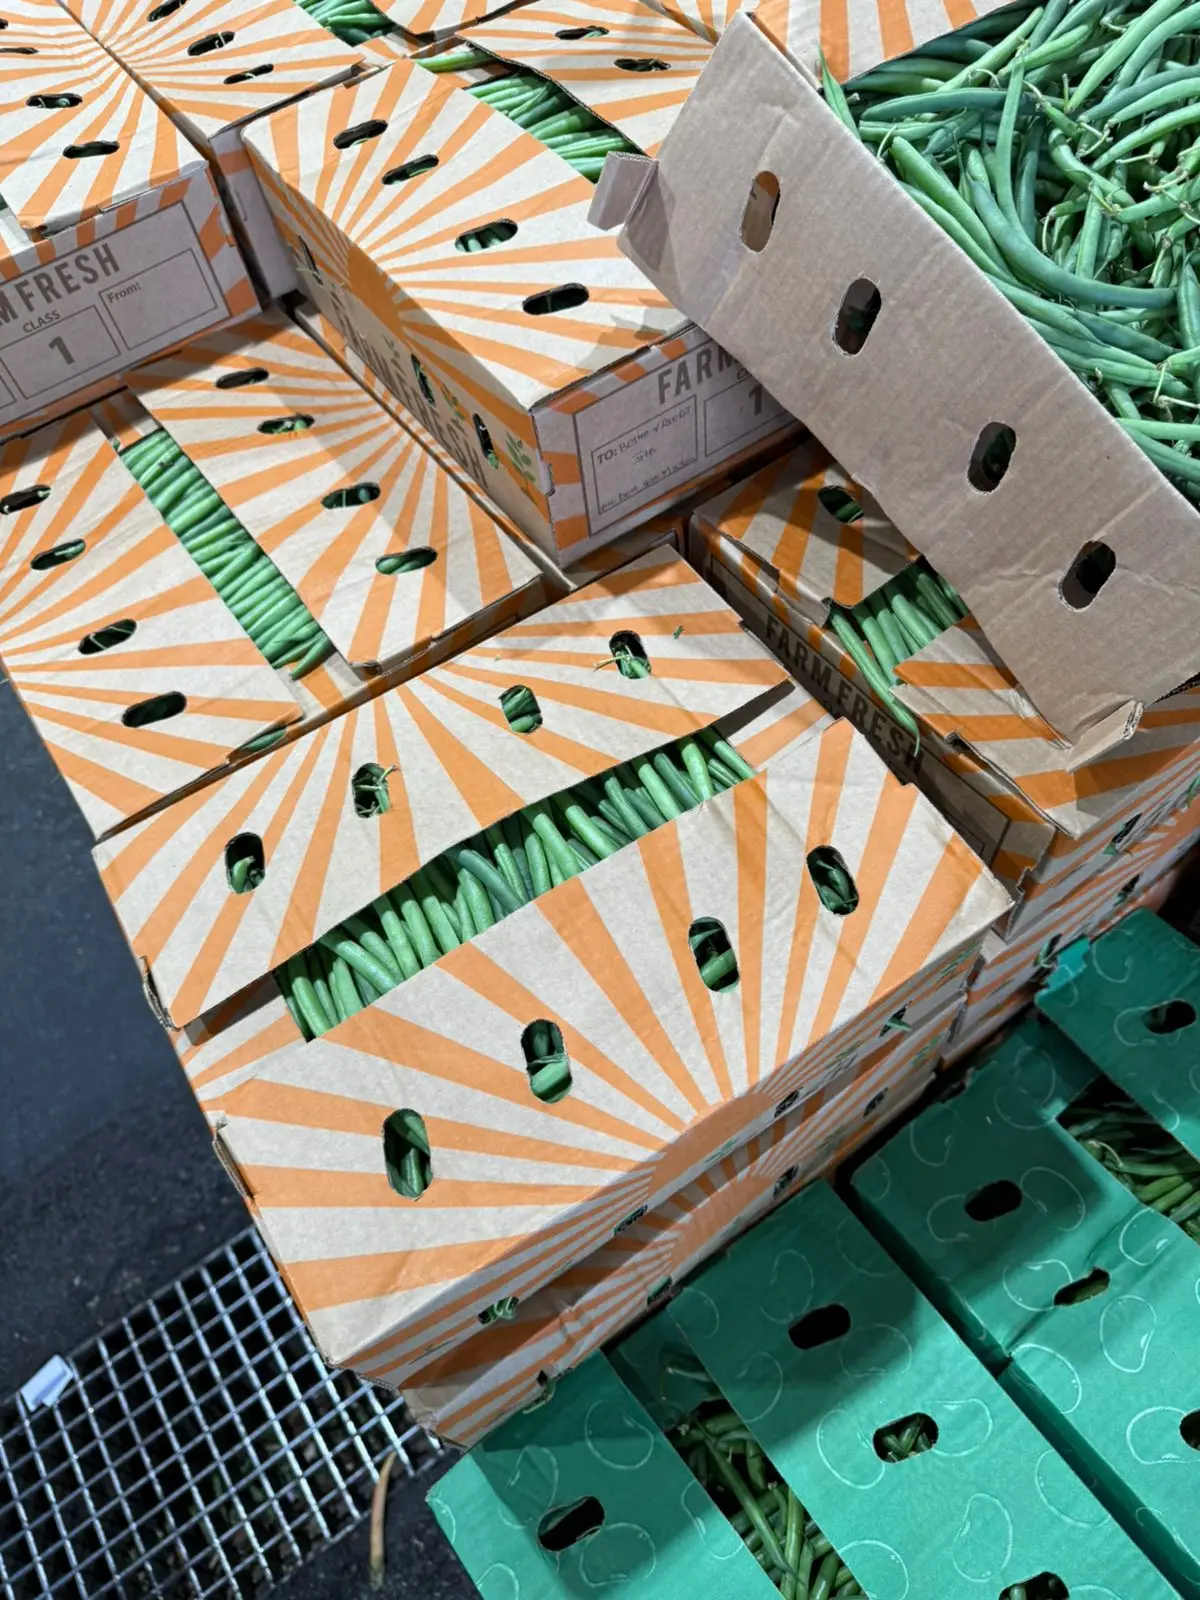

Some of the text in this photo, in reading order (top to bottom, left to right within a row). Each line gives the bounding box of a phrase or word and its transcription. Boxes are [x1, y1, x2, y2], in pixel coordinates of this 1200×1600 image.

[14, 243, 120, 312] FRESH
[107, 282, 141, 303] From:
[22, 309, 61, 333] CLASS
[48, 336, 75, 365] 1
[748, 383, 763, 416] 1
[597, 449, 617, 464] TO:
[766, 614, 925, 774] FARM FRESH
